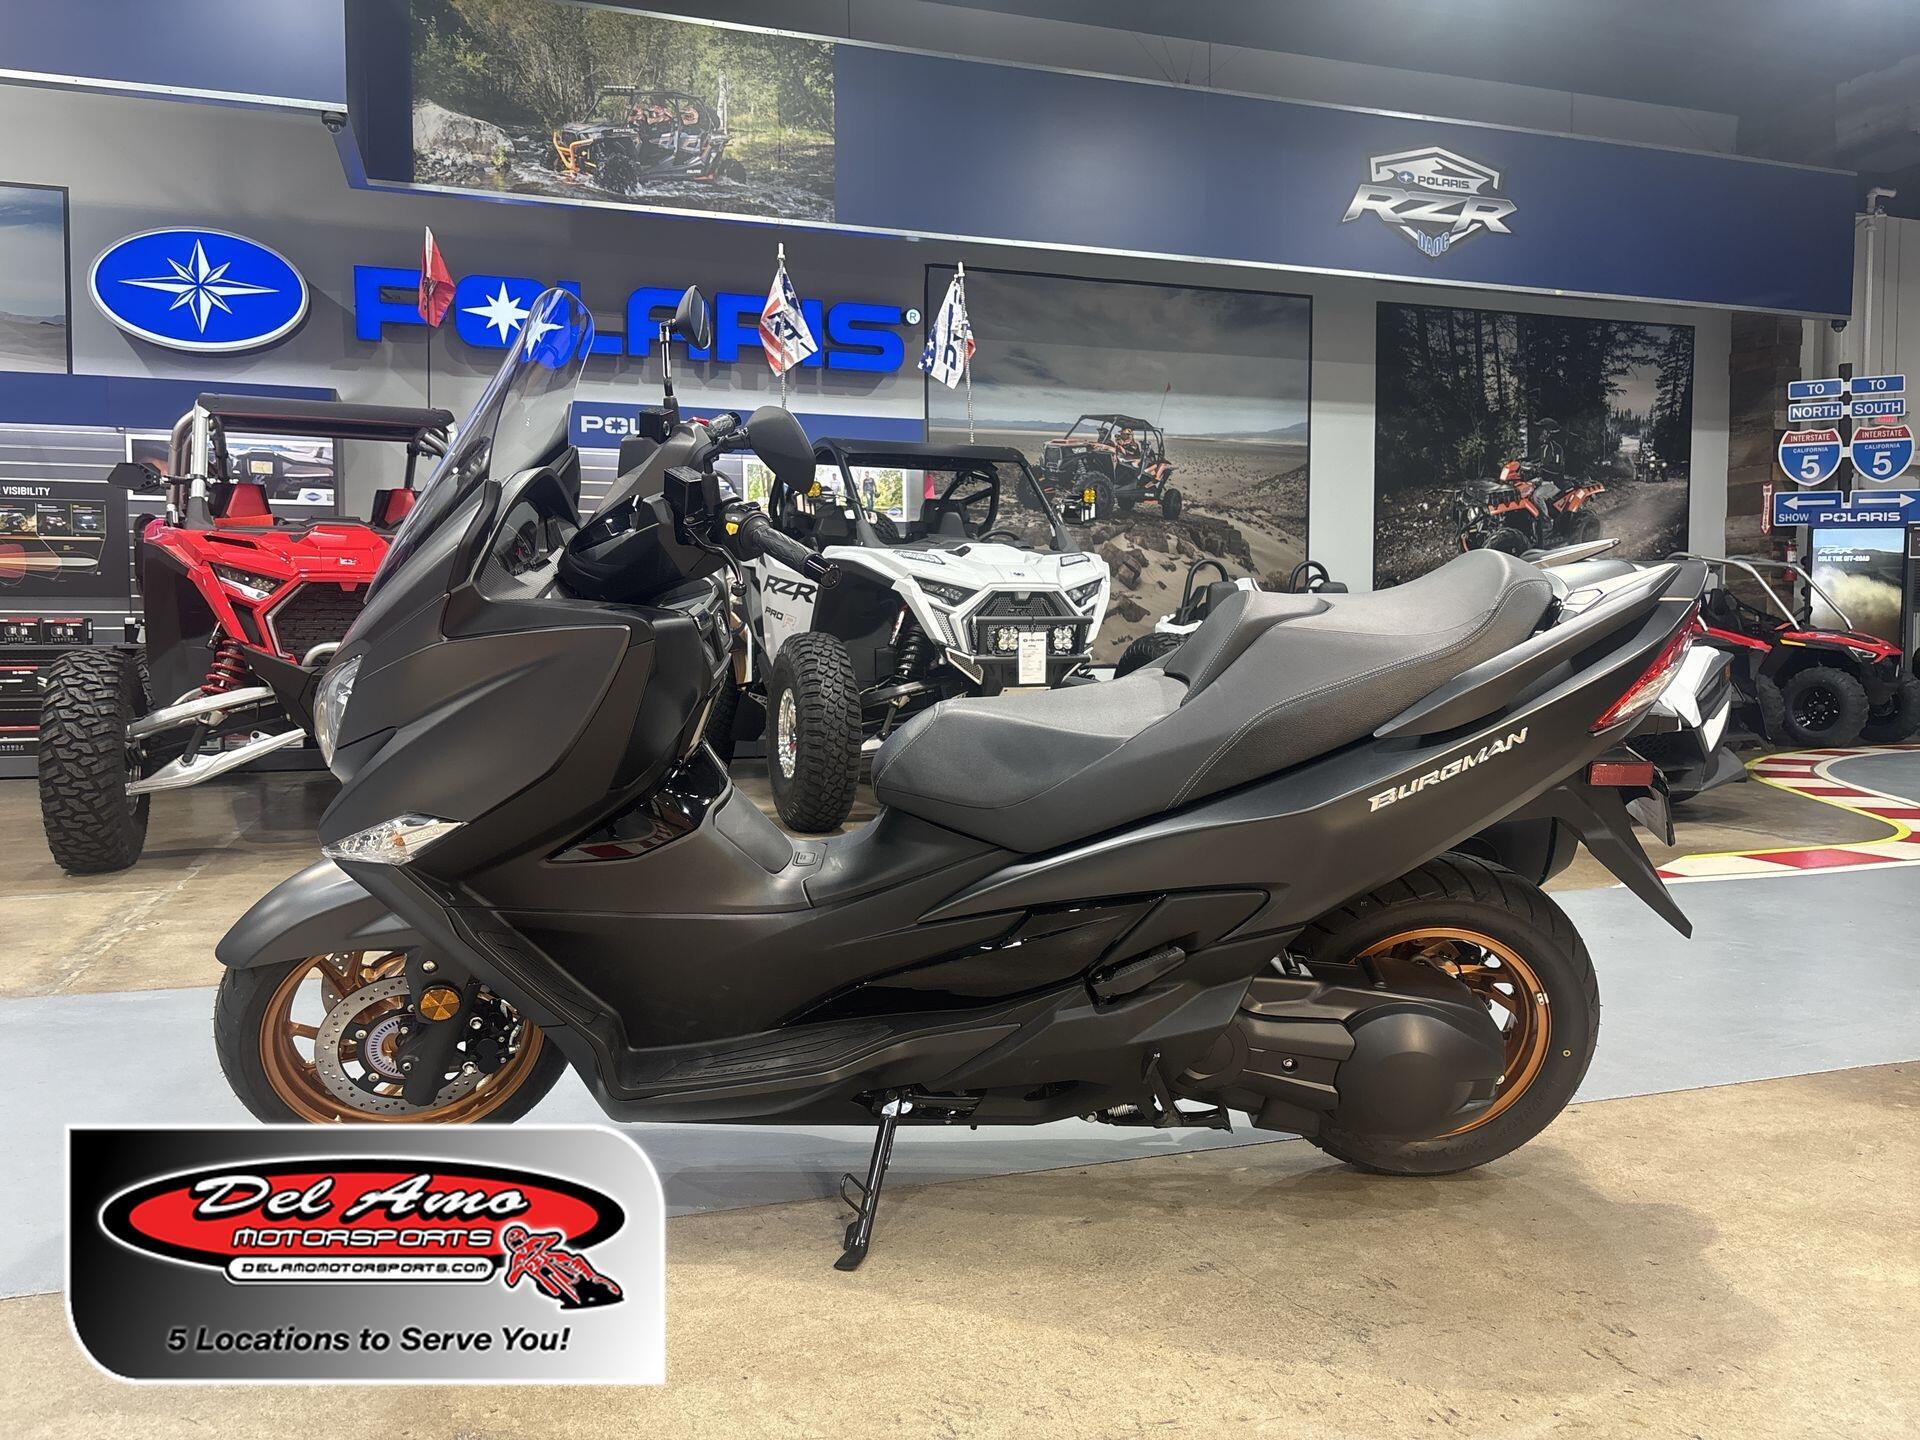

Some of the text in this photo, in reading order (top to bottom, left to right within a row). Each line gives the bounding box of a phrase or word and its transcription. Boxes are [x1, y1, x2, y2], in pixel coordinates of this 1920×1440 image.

[1417, 175, 1470, 189] POLARIS
[1342, 184, 1518, 234] RZR
[354, 264, 905, 374] POLARIS
[1807, 383, 1825, 395] TO
[1869, 379, 1887, 391] TO
[1792, 405, 1840, 418] NORTH
[1854, 402, 1901, 415] SOUTH
[1790, 433, 1831, 443] INTERSTATE
[1861, 429, 1903, 439] INTERSTATE
[1792, 446, 1829, 454] CALIFORNIA
[1864, 442, 1901, 450] CALIFORNIA
[1800, 455, 1821, 479] 5
[1872, 451, 1893, 475] 5
[2, 486, 51, 496] VISIBILITY
[1778, 513, 1809, 522] SHOW
[1819, 511, 1901, 522] POLARIS
[763, 574, 817, 604] RZR
[764, 606, 784, 621] PRO
[1367, 726, 1529, 813] BURGMAN
